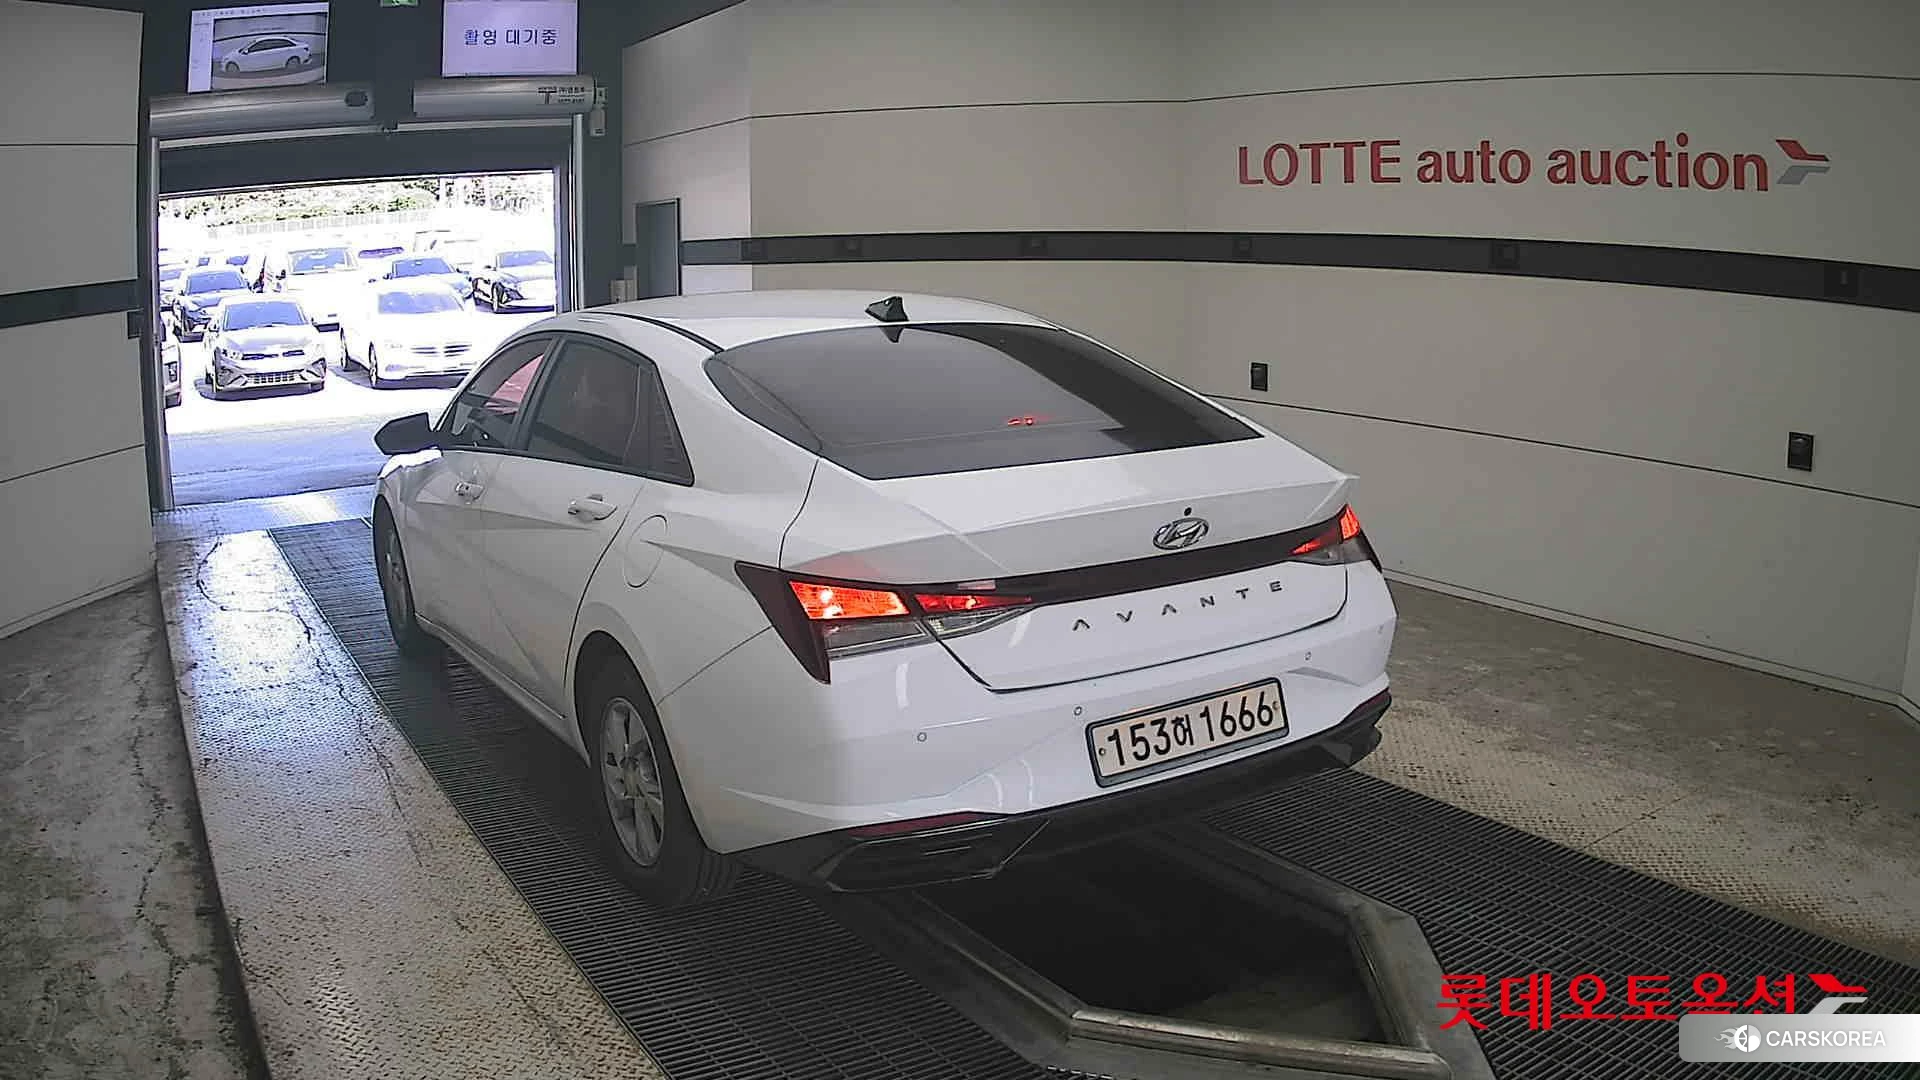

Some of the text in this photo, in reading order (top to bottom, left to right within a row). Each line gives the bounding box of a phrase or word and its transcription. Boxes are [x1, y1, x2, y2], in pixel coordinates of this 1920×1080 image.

[505, 28, 558, 46] 대기중
[1239, 132, 1769, 191] LOTTE auto auction
[1072, 580, 1283, 632] AVANTE
[1199, 691, 1274, 742] 1666
